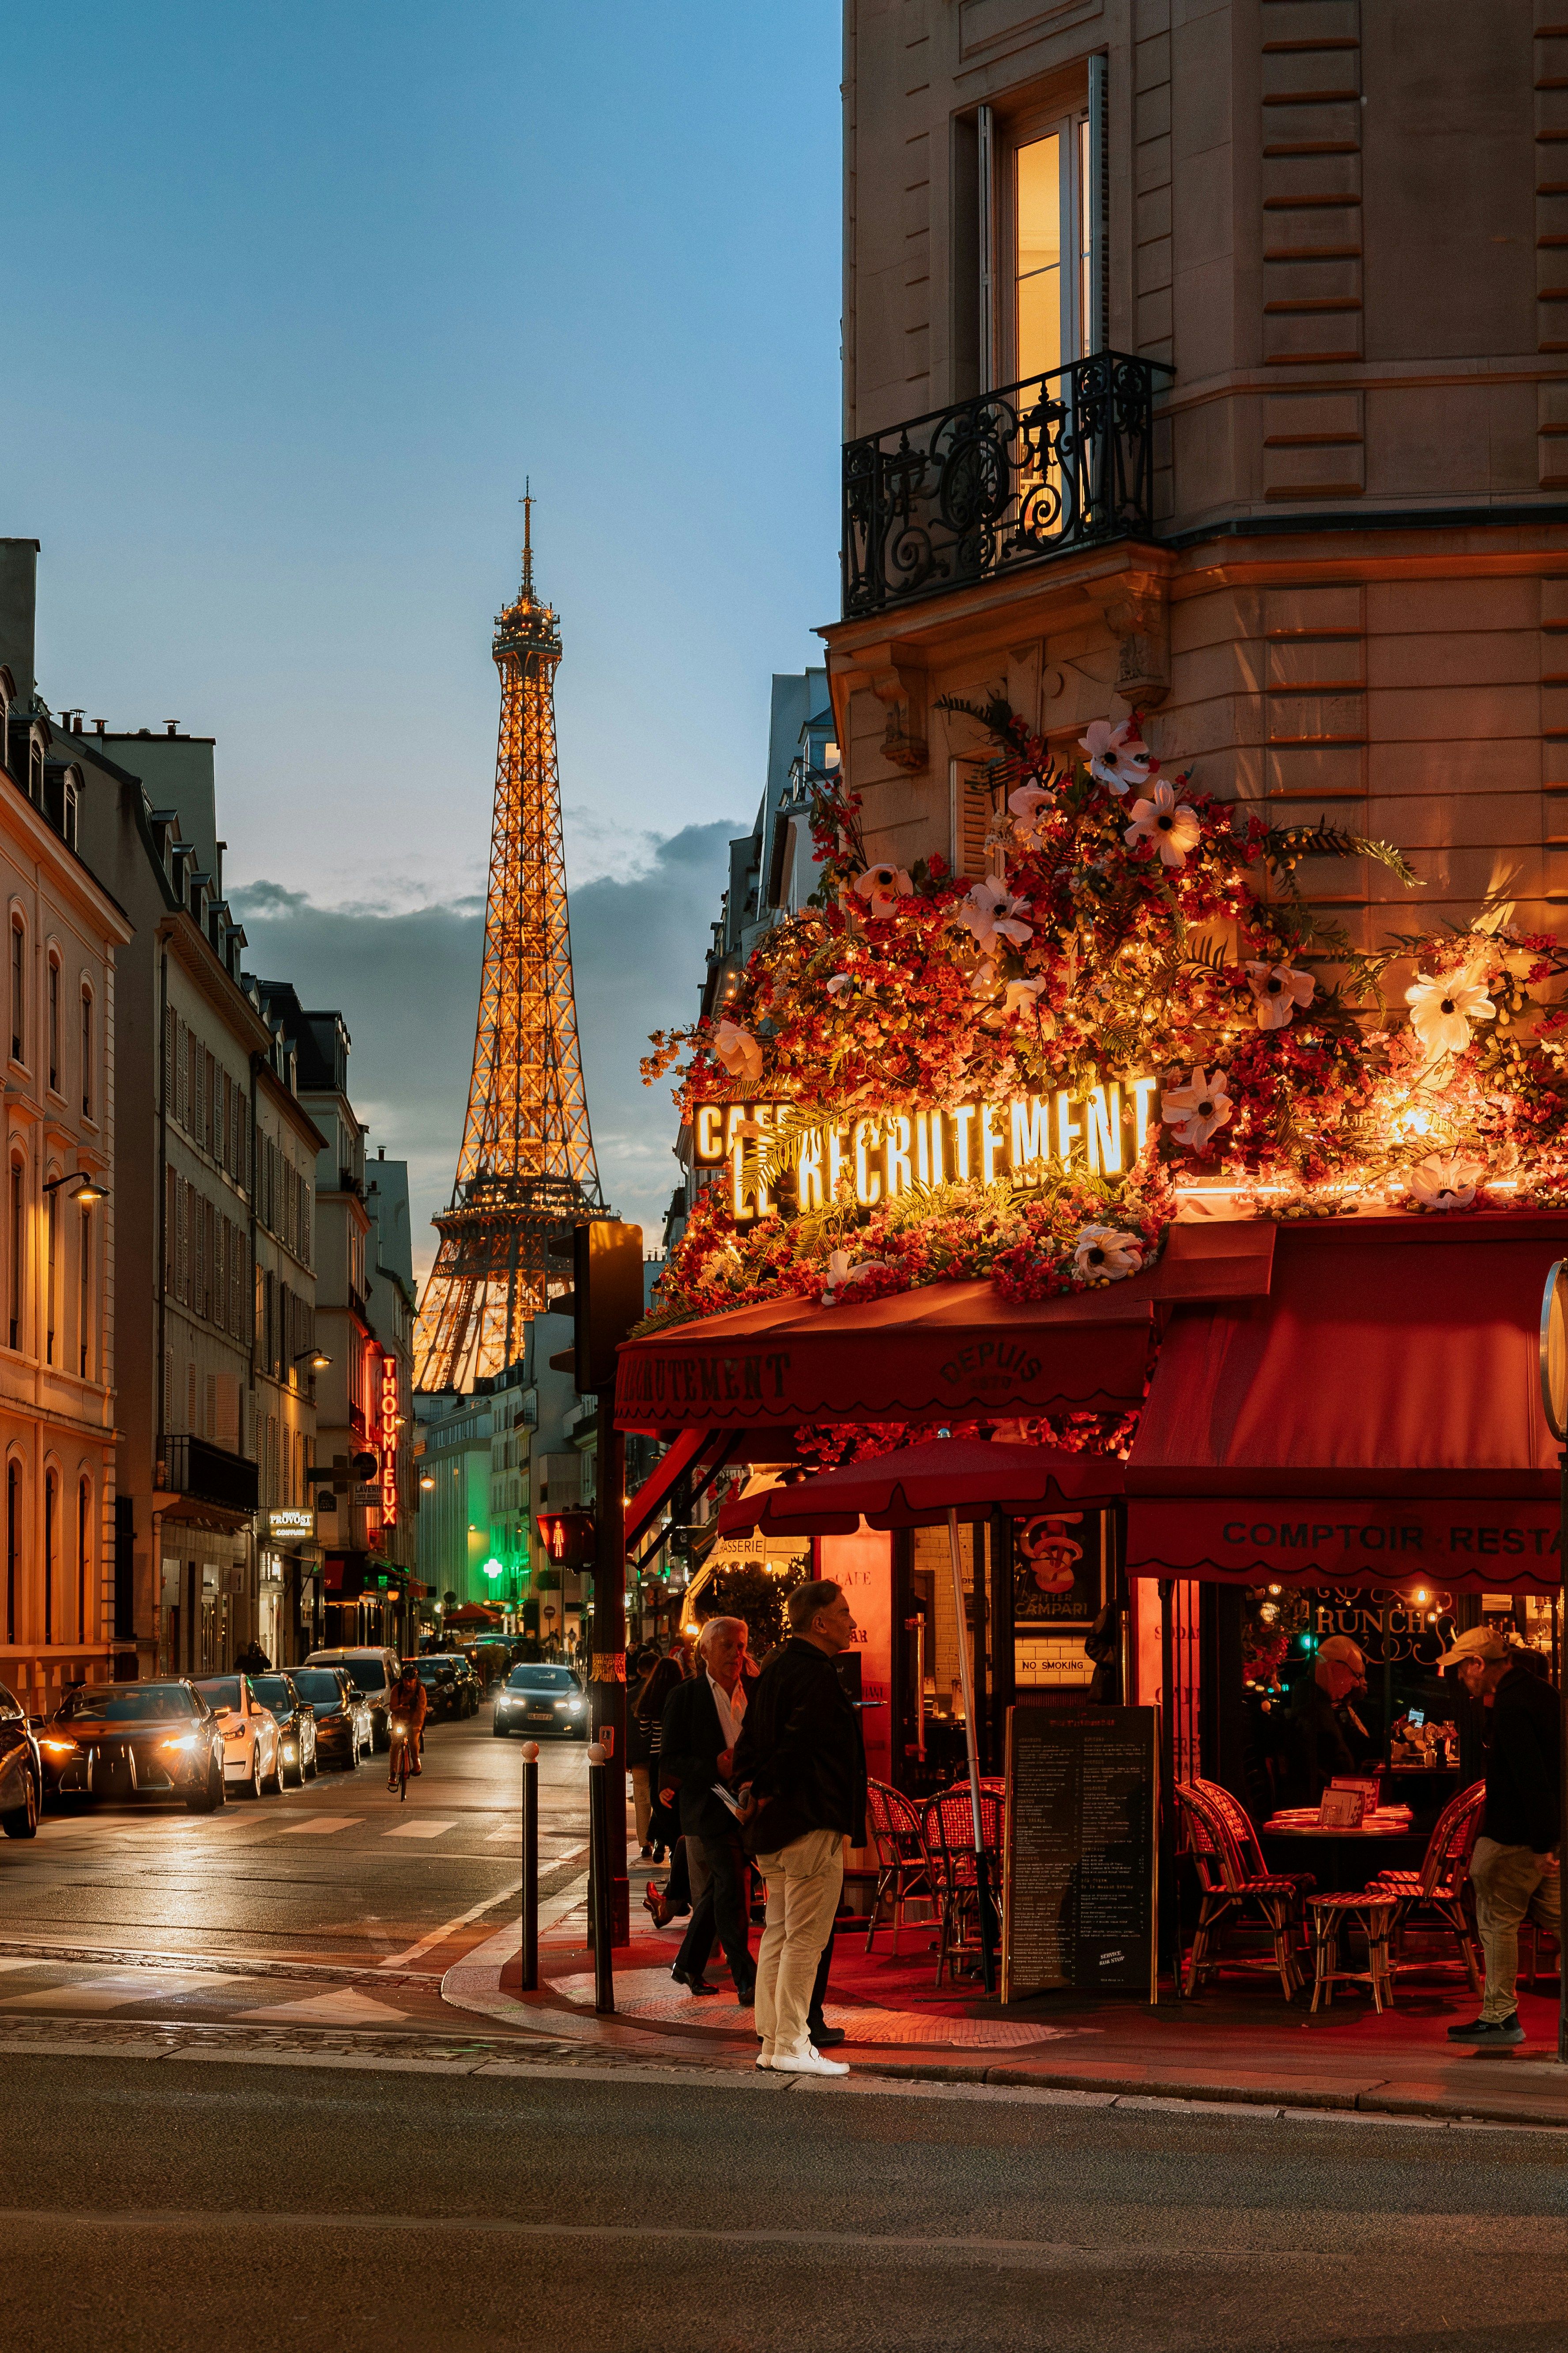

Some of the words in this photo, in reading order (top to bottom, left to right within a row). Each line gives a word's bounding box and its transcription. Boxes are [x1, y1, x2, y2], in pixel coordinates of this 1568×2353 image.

[798, 1076, 1156, 1213] RECRUTEMENT
[940, 1342, 1042, 1384] DEPUIS
[382, 1358, 396, 1524] THOUMIEUX
[270, 1515, 312, 1524] PROVOST
[1221, 1522, 1424, 1551] COMPTOIR
[1014, 1602, 1088, 1615] CAMPARI
[1022, 1661, 1037, 1669] NO
[1041, 1661, 1084, 1669] SMOKING
